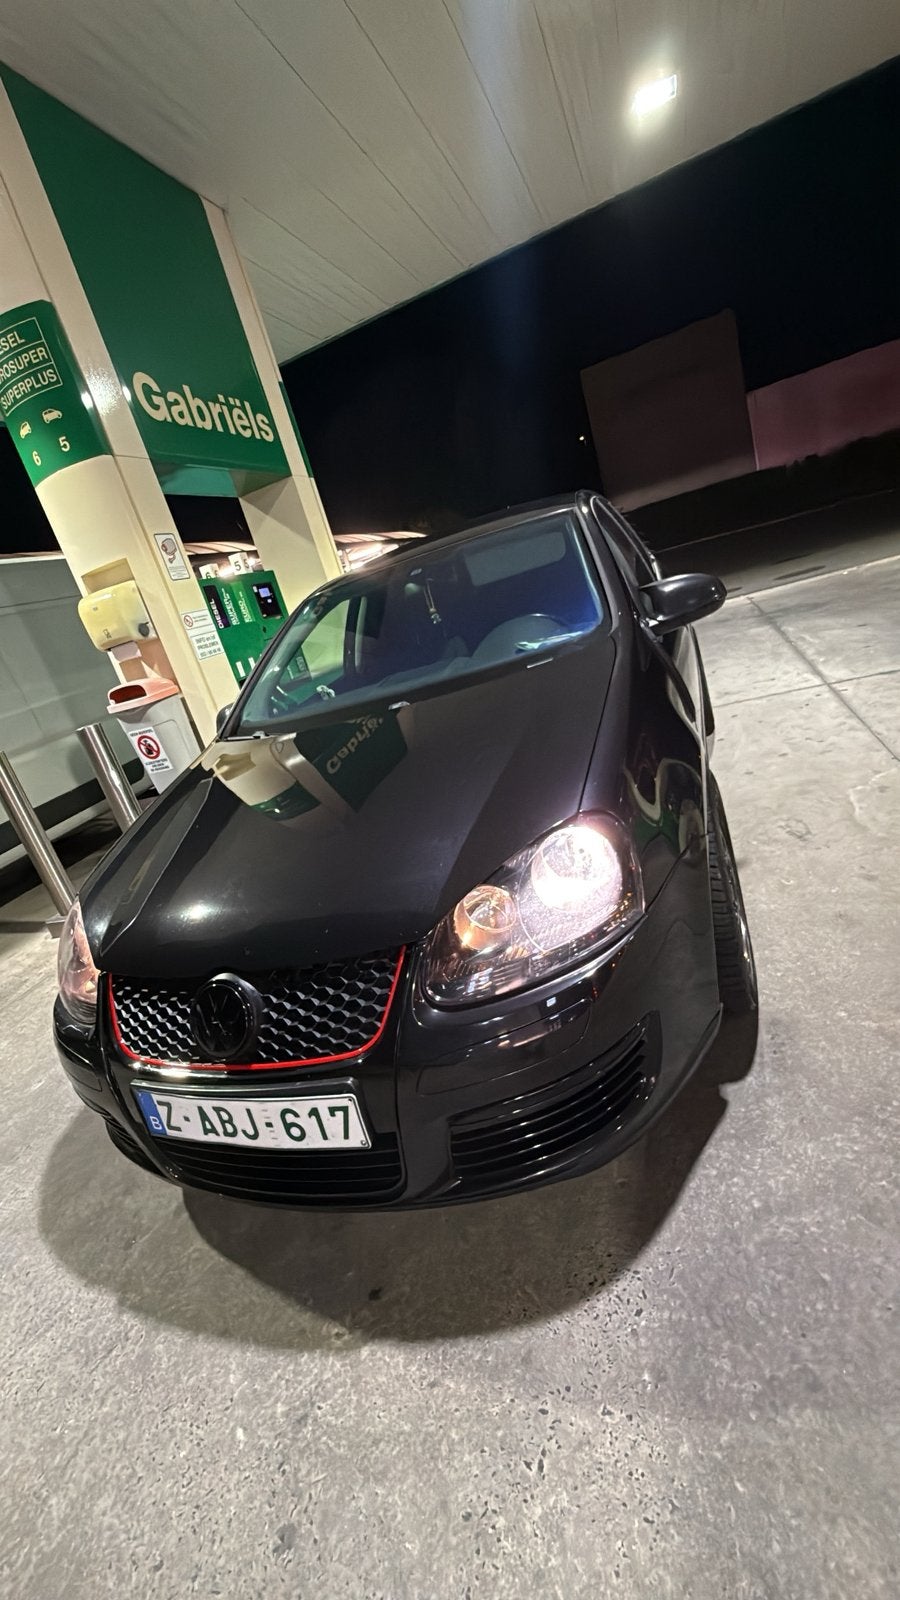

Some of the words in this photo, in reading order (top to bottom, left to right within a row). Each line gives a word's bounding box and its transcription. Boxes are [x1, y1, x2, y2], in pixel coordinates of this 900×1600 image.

[1, 369, 57, 410] SUPERPLUS
[132, 371, 274, 443] Gabriëls
[32, 451, 42, 466] 6
[59, 436, 71, 452] 5
[234, 560, 242, 571] 5
[209, 598, 225, 629] DIESEL
[149, 1115, 162, 1130] B
[157, 1101, 350, 1142] Z-ABJ-617
